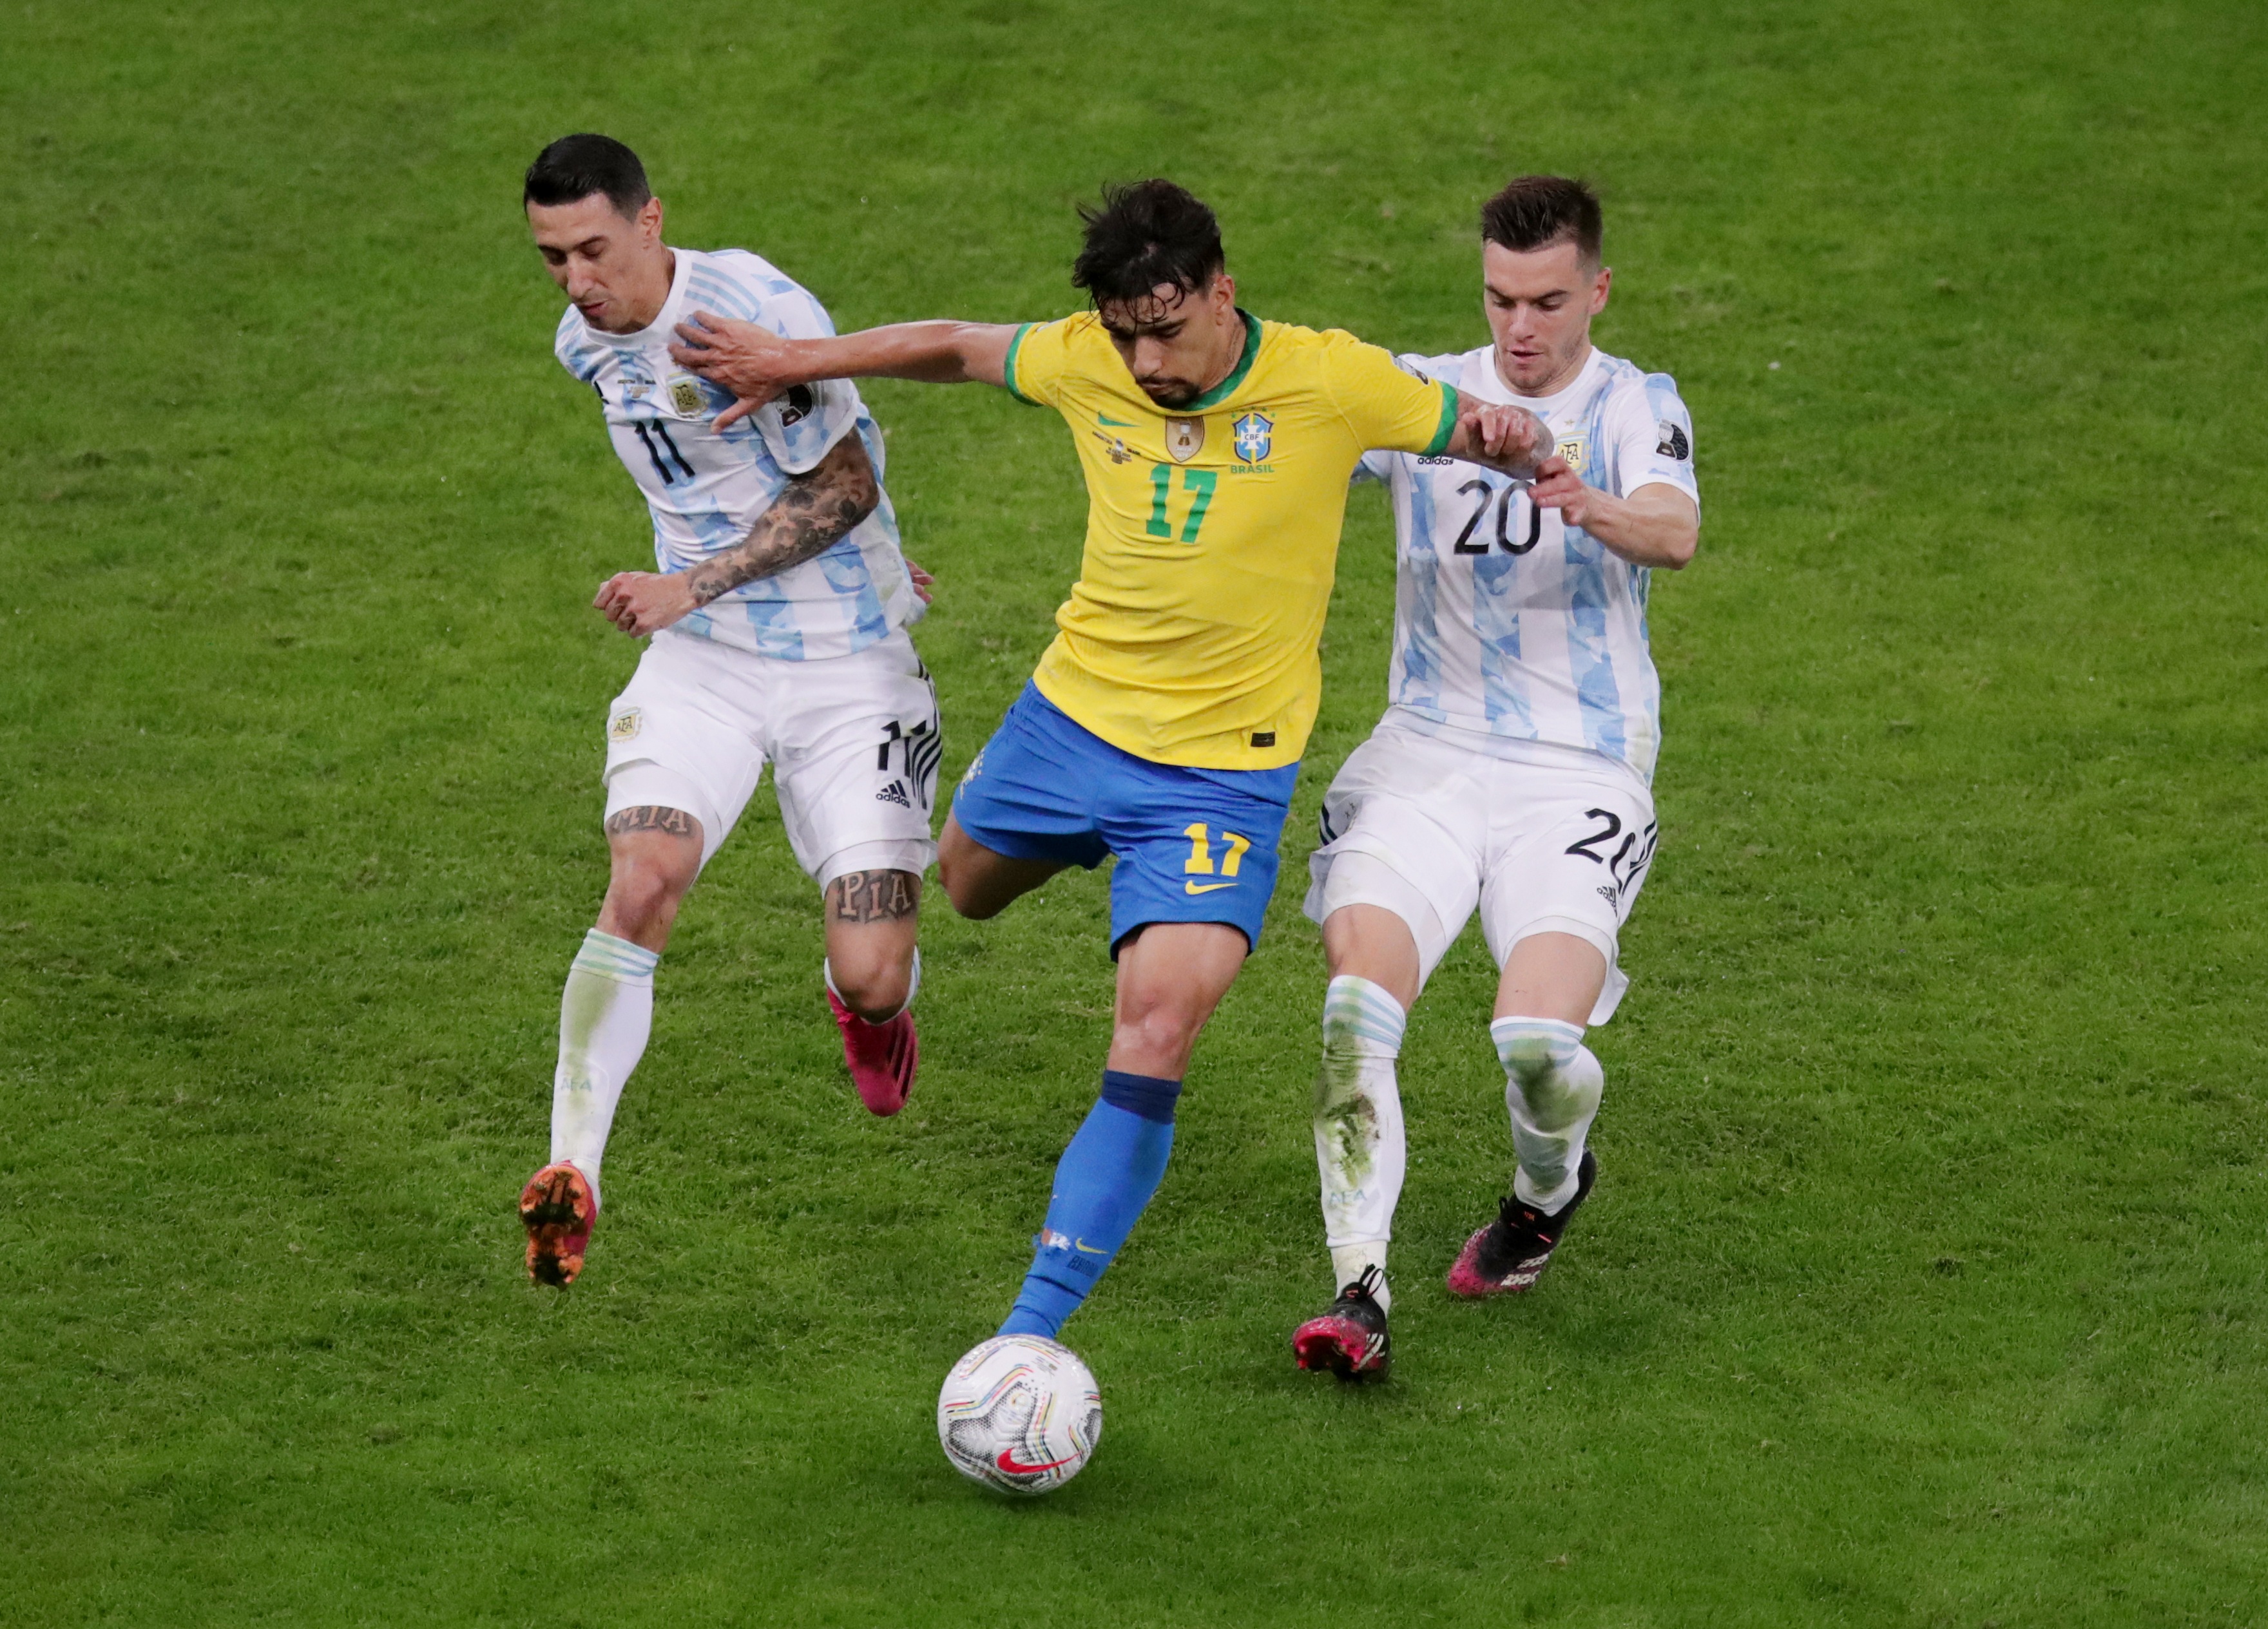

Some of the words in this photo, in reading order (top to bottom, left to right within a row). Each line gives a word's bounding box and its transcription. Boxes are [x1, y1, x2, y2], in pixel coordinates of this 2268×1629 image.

[634, 418, 696, 486] 11
[1230, 464, 1275, 473] BRASIL
[1418, 455, 1454, 465] adidas
[1146, 463, 1218, 544] 17
[1454, 479, 1541, 556] 20
[614, 716, 633, 732] AFA
[878, 720, 927, 778] 11
[613, 805, 687, 832] MIA
[1184, 823, 1251, 877] 17
[840, 872, 911, 919] PIA
